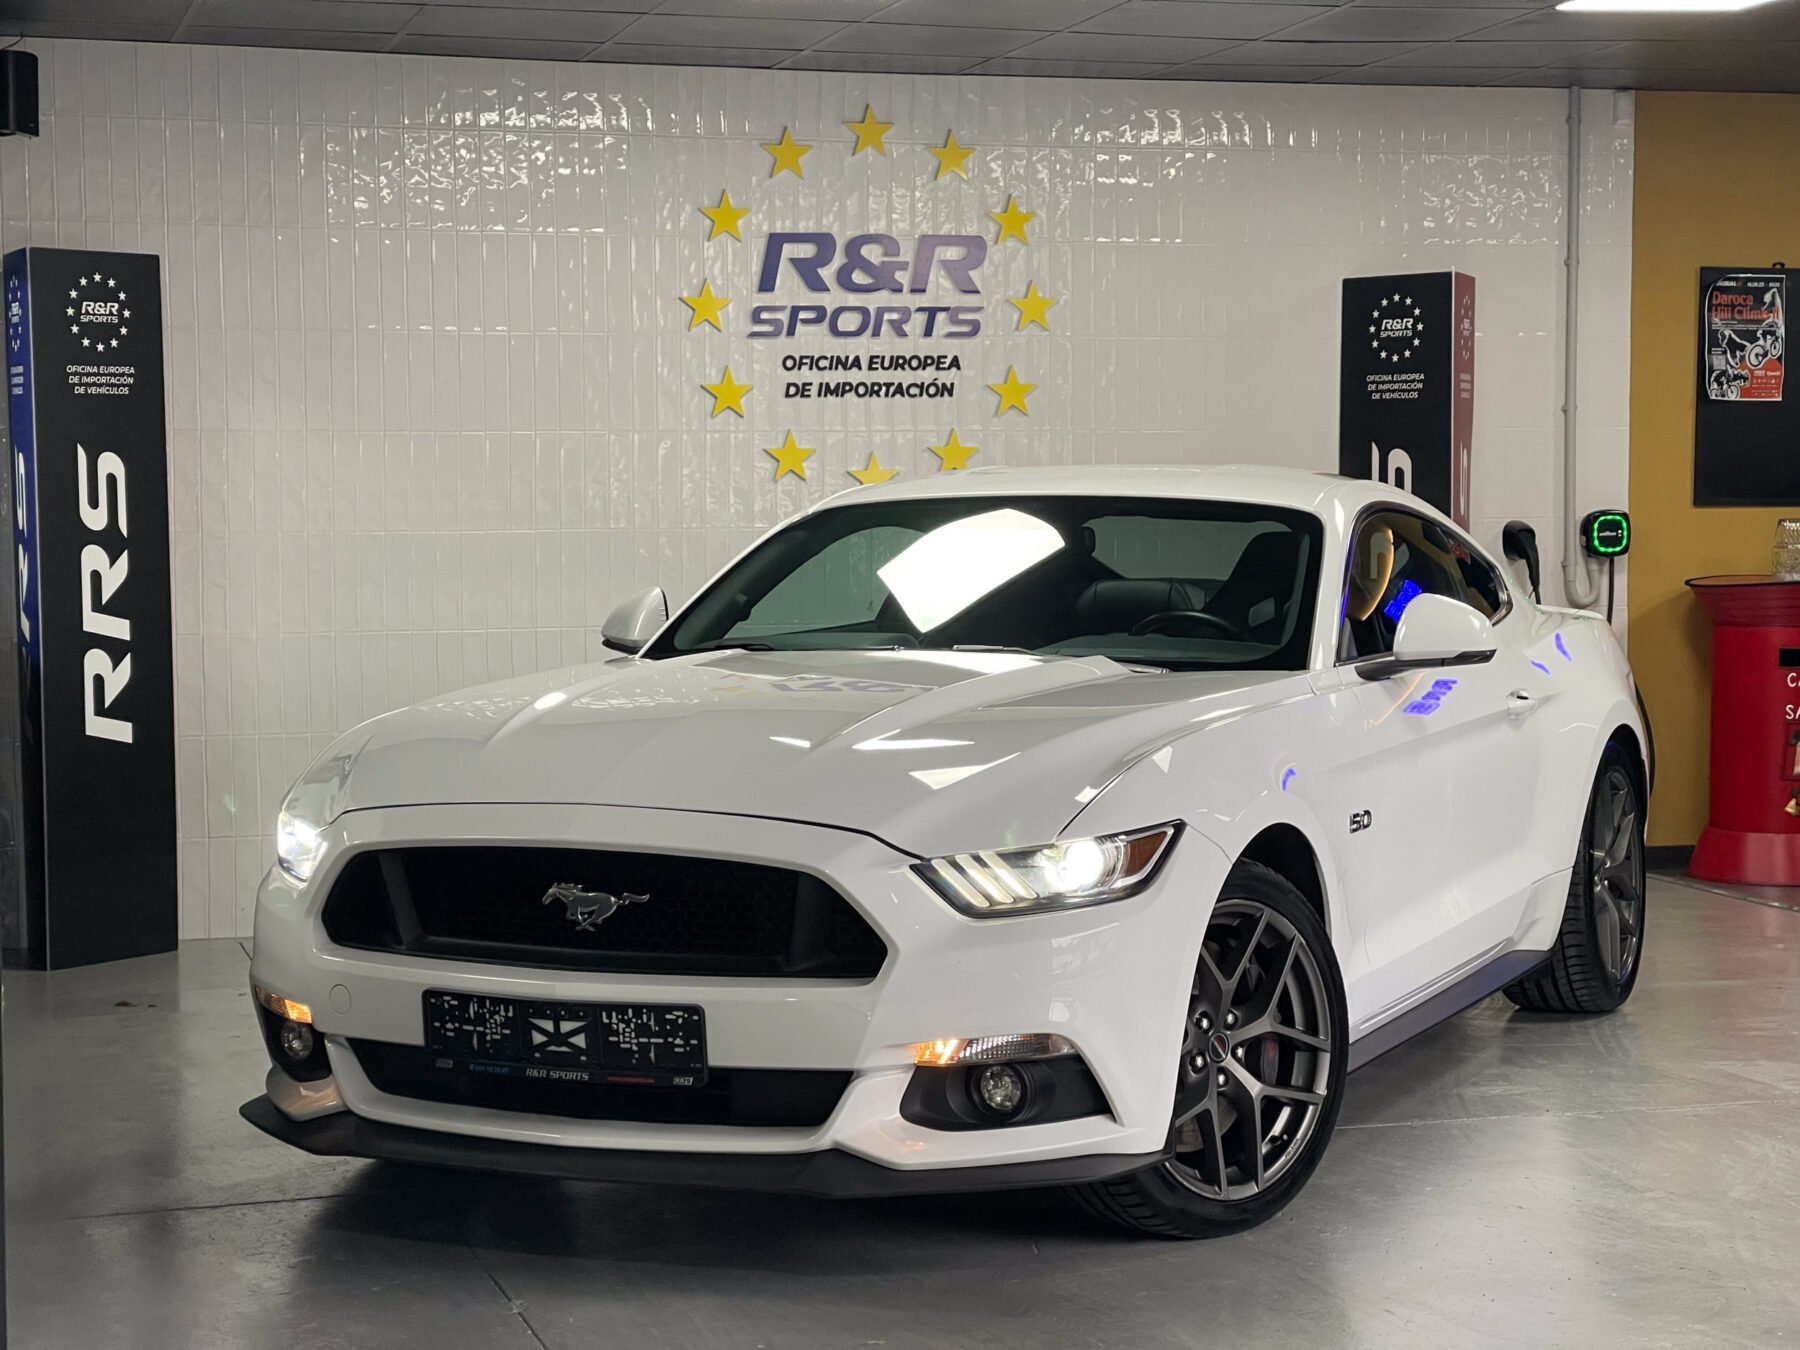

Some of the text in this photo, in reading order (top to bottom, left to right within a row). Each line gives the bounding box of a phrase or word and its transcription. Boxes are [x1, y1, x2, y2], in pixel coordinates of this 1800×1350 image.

[758, 232, 988, 294] R&R
[1712, 291, 1753, 305] Daroca
[81, 301, 119, 315] R&R
[1712, 306, 1731, 320] Hill
[80, 315, 119, 323] SPORTS
[747, 305, 985, 339] SPORTS
[1381, 318, 1414, 330] R&R
[1380, 329, 1413, 338] SPORTS
[782, 355, 961, 371] OFICINA EUROPEA
[66, 365, 135, 374] OFICINA EUROPEA
[81, 375, 134, 384] IMPORTACIÓN
[1366, 372, 1425, 382] OFICINA EUROPEA
[74, 385, 129, 394] DE VEHÍCULOS
[785, 377, 955, 398] DE IMPORTACIÓN
[1367, 381, 1423, 391] DE IMPORTACIÓN
[1371, 390, 1419, 400] DE VEHÍCULOS
[77, 443, 133, 744] RRS
[525, 1068, 589, 1081] R&R SPORTS
